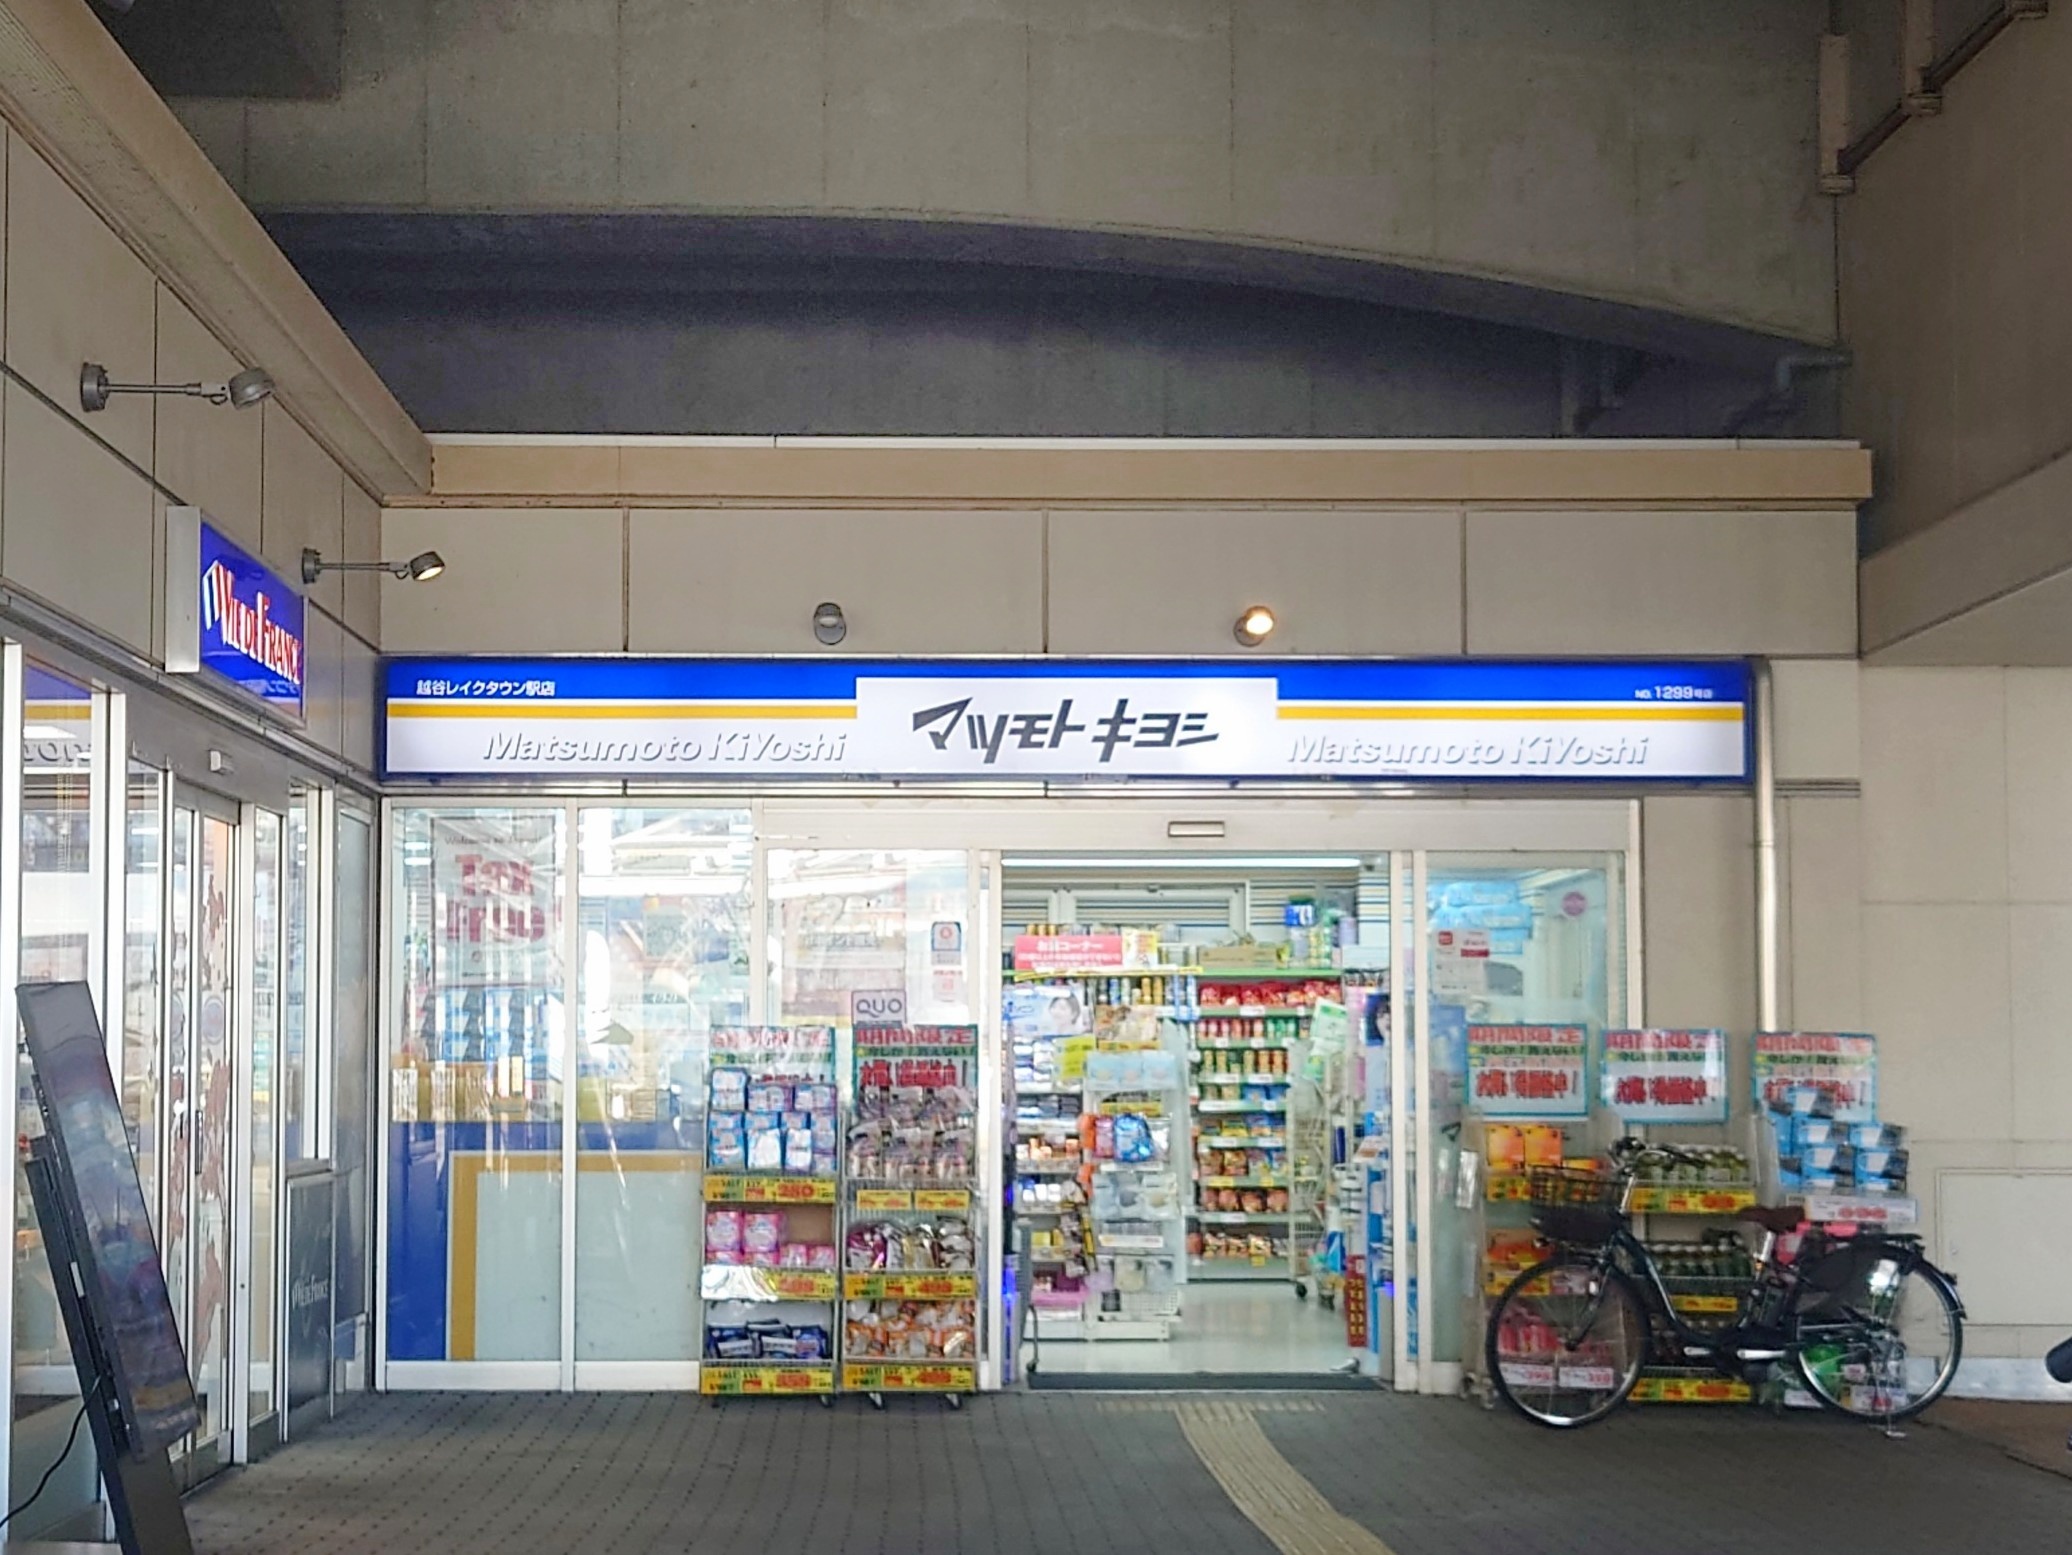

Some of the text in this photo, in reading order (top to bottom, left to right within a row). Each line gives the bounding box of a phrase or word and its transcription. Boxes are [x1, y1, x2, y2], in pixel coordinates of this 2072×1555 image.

[255, 590, 302, 685] FRANC
[416, 679, 556, 697] 越谷レイクタウン駅店
[913, 697, 1219, 764] マツモトキヨシ
[482, 731, 848, 762] Matsumoto KiYoshi
[1287, 735, 1650, 765] Matsumoto KiYoshi
[856, 998, 903, 1019] QUO
